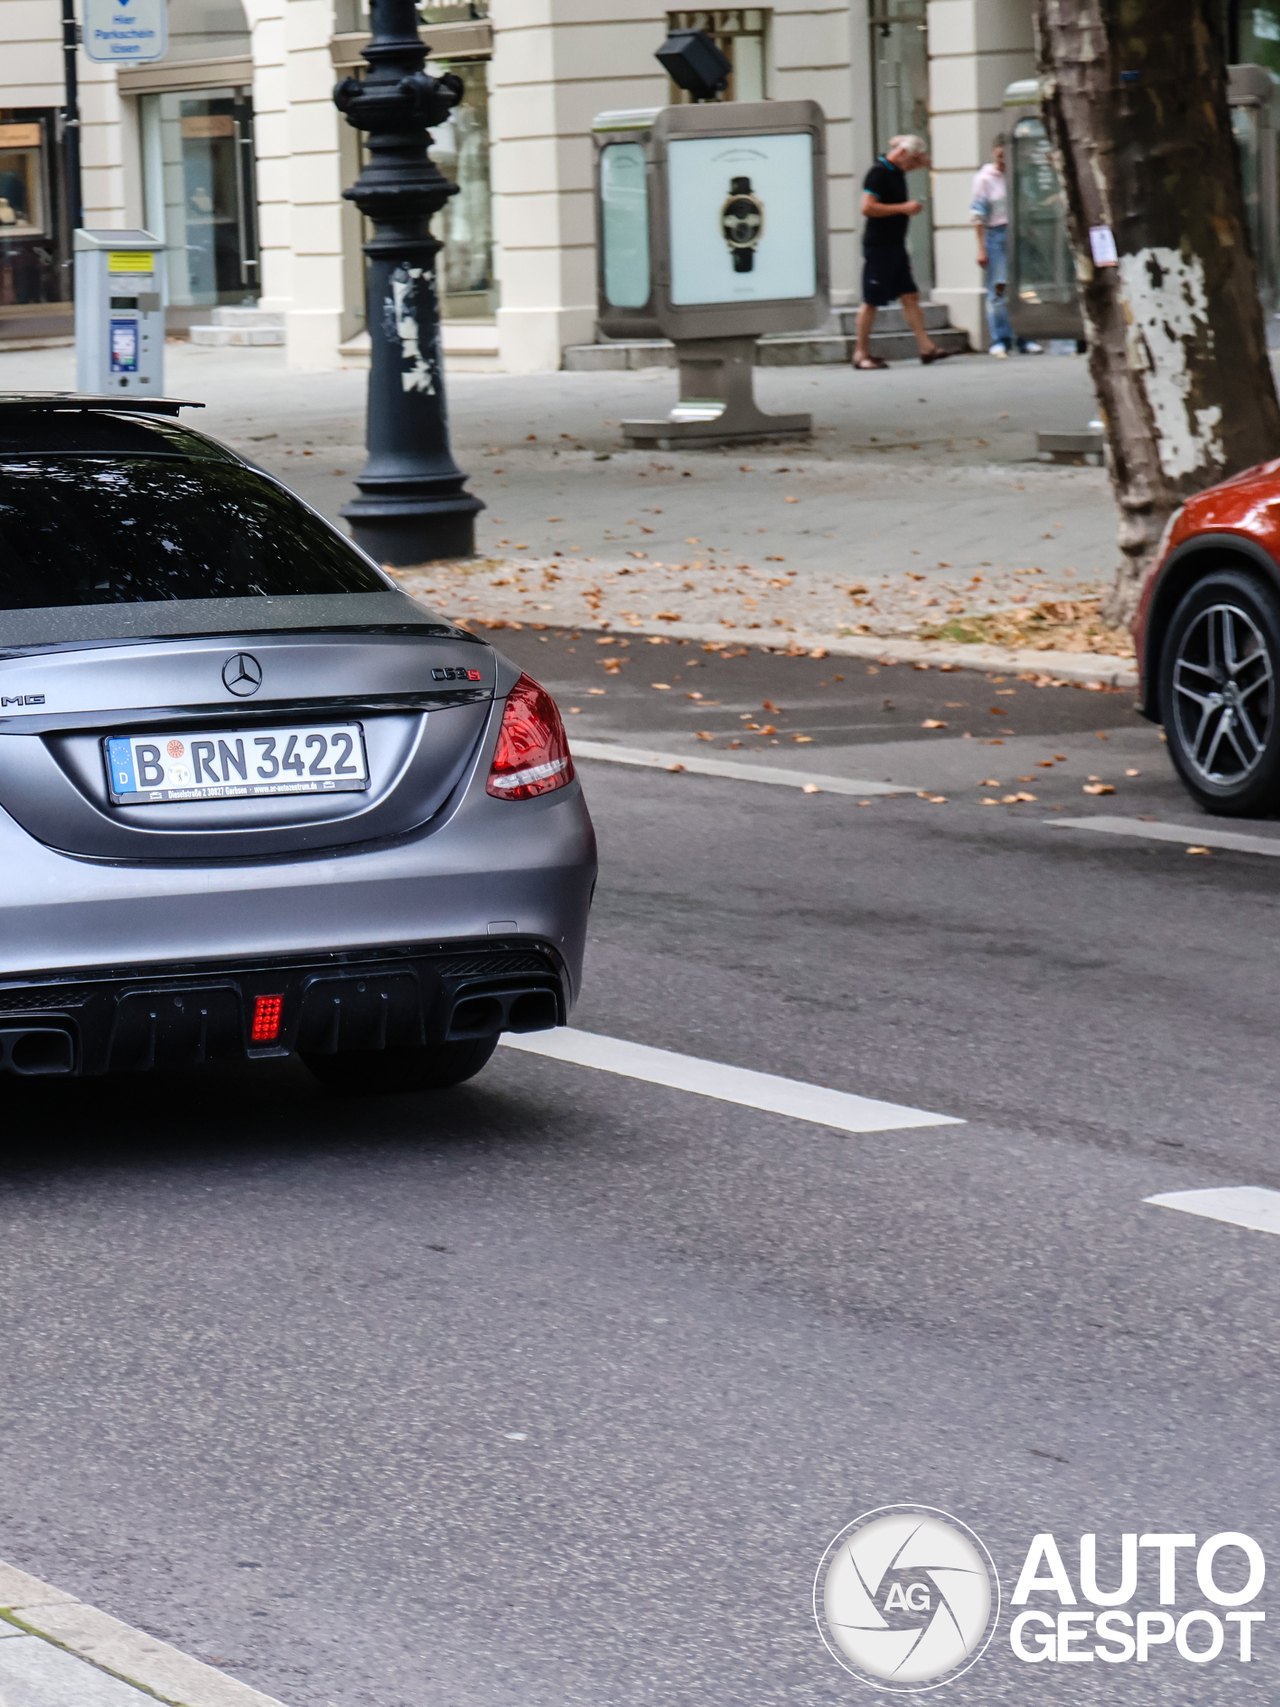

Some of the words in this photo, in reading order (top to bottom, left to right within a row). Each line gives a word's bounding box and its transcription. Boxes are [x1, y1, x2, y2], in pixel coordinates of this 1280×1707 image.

[112, 15, 136, 25] Hier
[95, 29, 155, 40] Parkschein
[135, 744, 165, 787] B
[191, 738, 248, 783] RN
[253, 733, 357, 779] 3422
[120, 772, 129, 785] D
[167, 790, 202, 799] Dieselstraße
[225, 785, 247, 794] Garbsen
